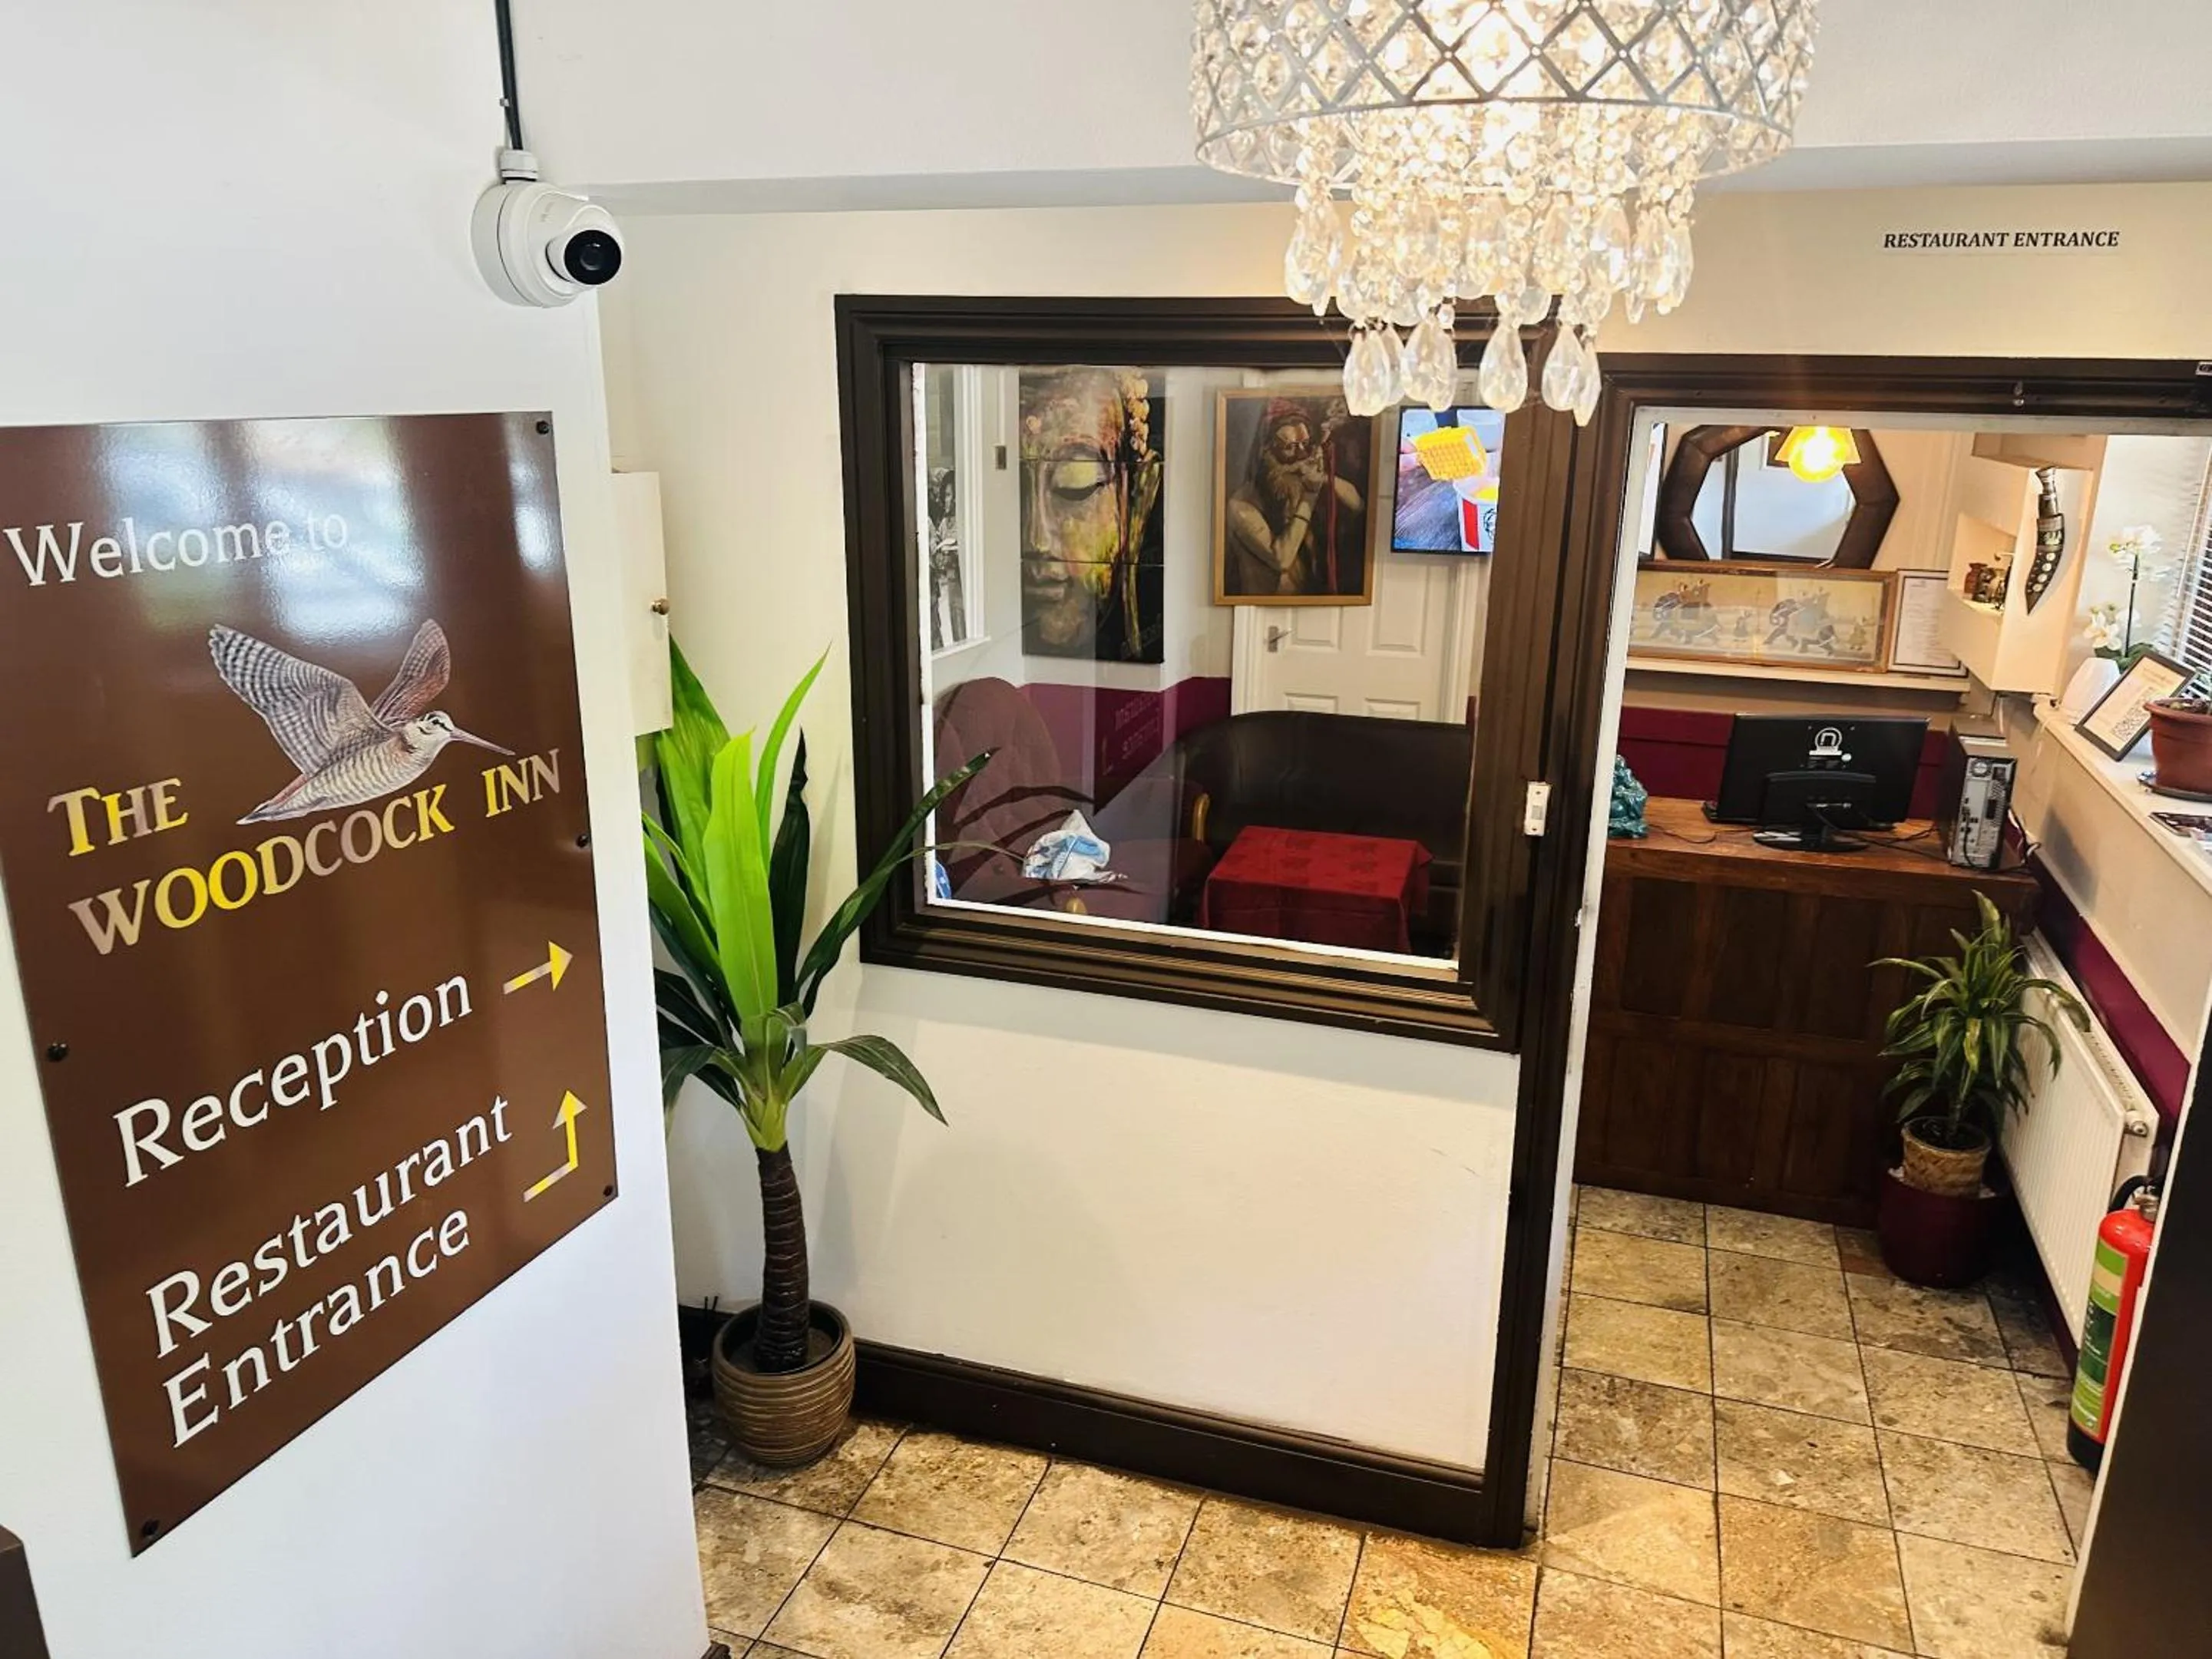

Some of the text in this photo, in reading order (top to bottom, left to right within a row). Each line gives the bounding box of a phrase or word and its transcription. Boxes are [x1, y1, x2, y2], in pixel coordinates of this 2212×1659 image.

[1883, 231, 2120, 249] RESTAURANT ENTRANCE
[3, 511, 349, 587] Welcome to
[47, 778, 189, 858] THE
[68, 749, 560, 955] WOODCOCK INN
[112, 973, 473, 1188] Reception
[145, 1094, 513, 1360] Restaurant
[161, 1208, 470, 1449] Entrance
